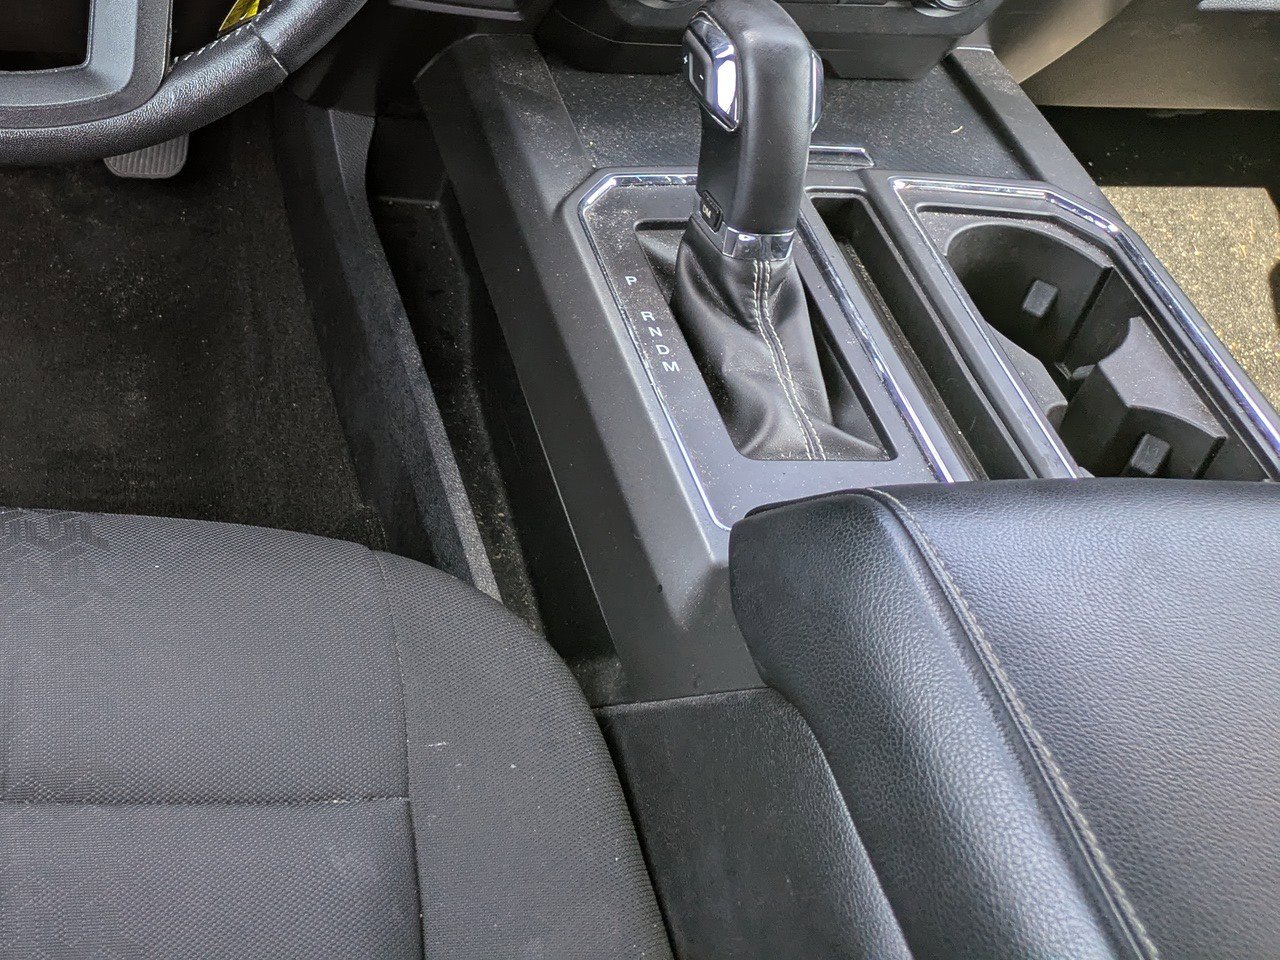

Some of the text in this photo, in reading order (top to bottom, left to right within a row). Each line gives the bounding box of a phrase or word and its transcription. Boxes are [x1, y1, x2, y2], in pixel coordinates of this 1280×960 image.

[625, 276, 638, 286] P
[640, 311, 656, 322] R
[648, 326, 663, 338] N
[656, 344, 670, 355] D
[662, 361, 680, 372] M
